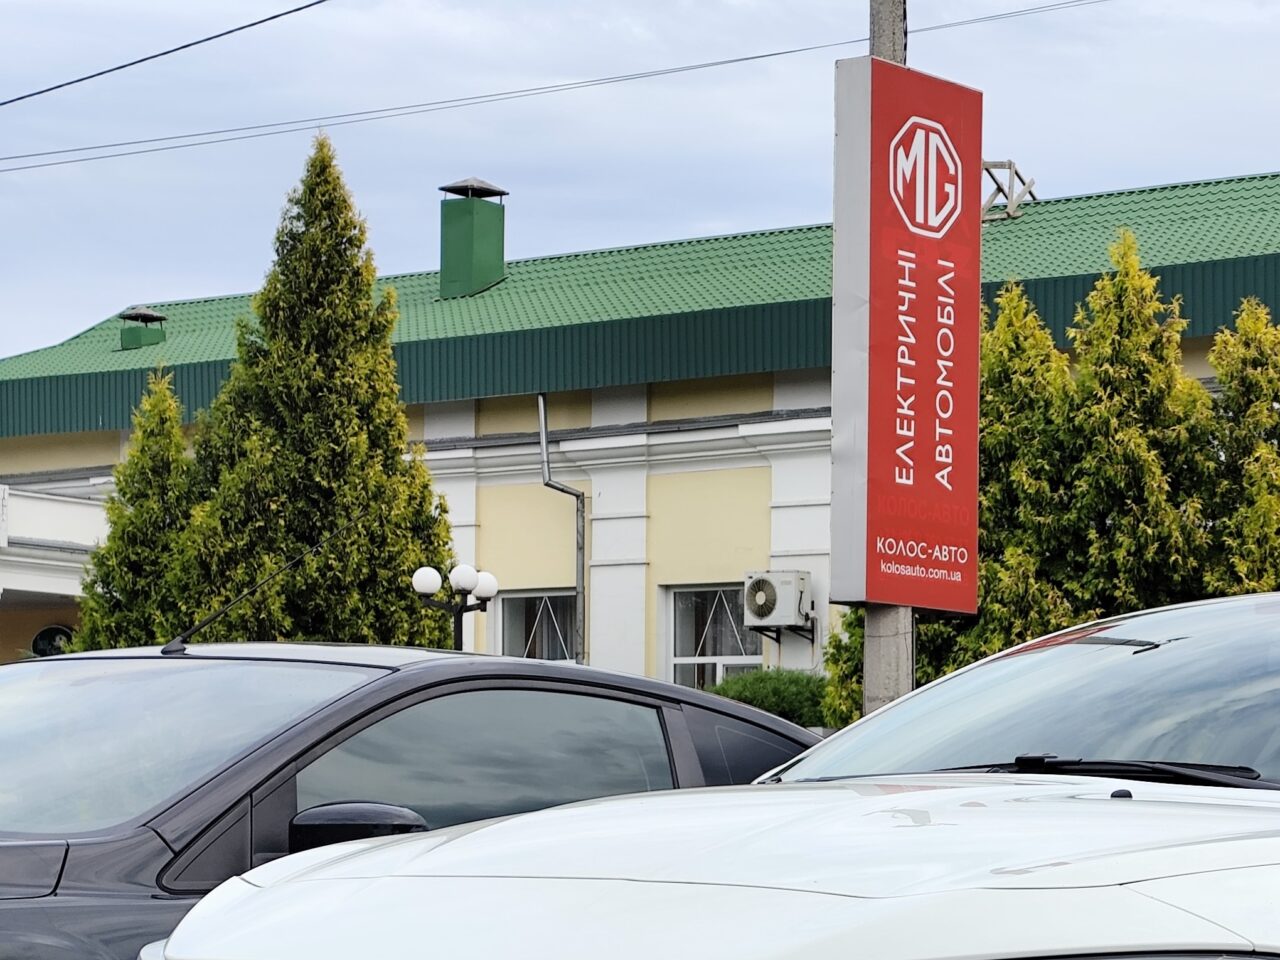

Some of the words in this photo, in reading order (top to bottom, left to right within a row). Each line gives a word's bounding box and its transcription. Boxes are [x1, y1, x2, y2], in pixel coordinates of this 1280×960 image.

[896, 127, 956, 228] MG
[895, 249, 917, 486] ЕЛЕКТРИЧНІ
[934, 259, 955, 492] АВТОМОБІЛІ
[876, 536, 969, 564] КОЛОС-АВТО
[880, 559, 962, 582] kolosauto.com.ua
